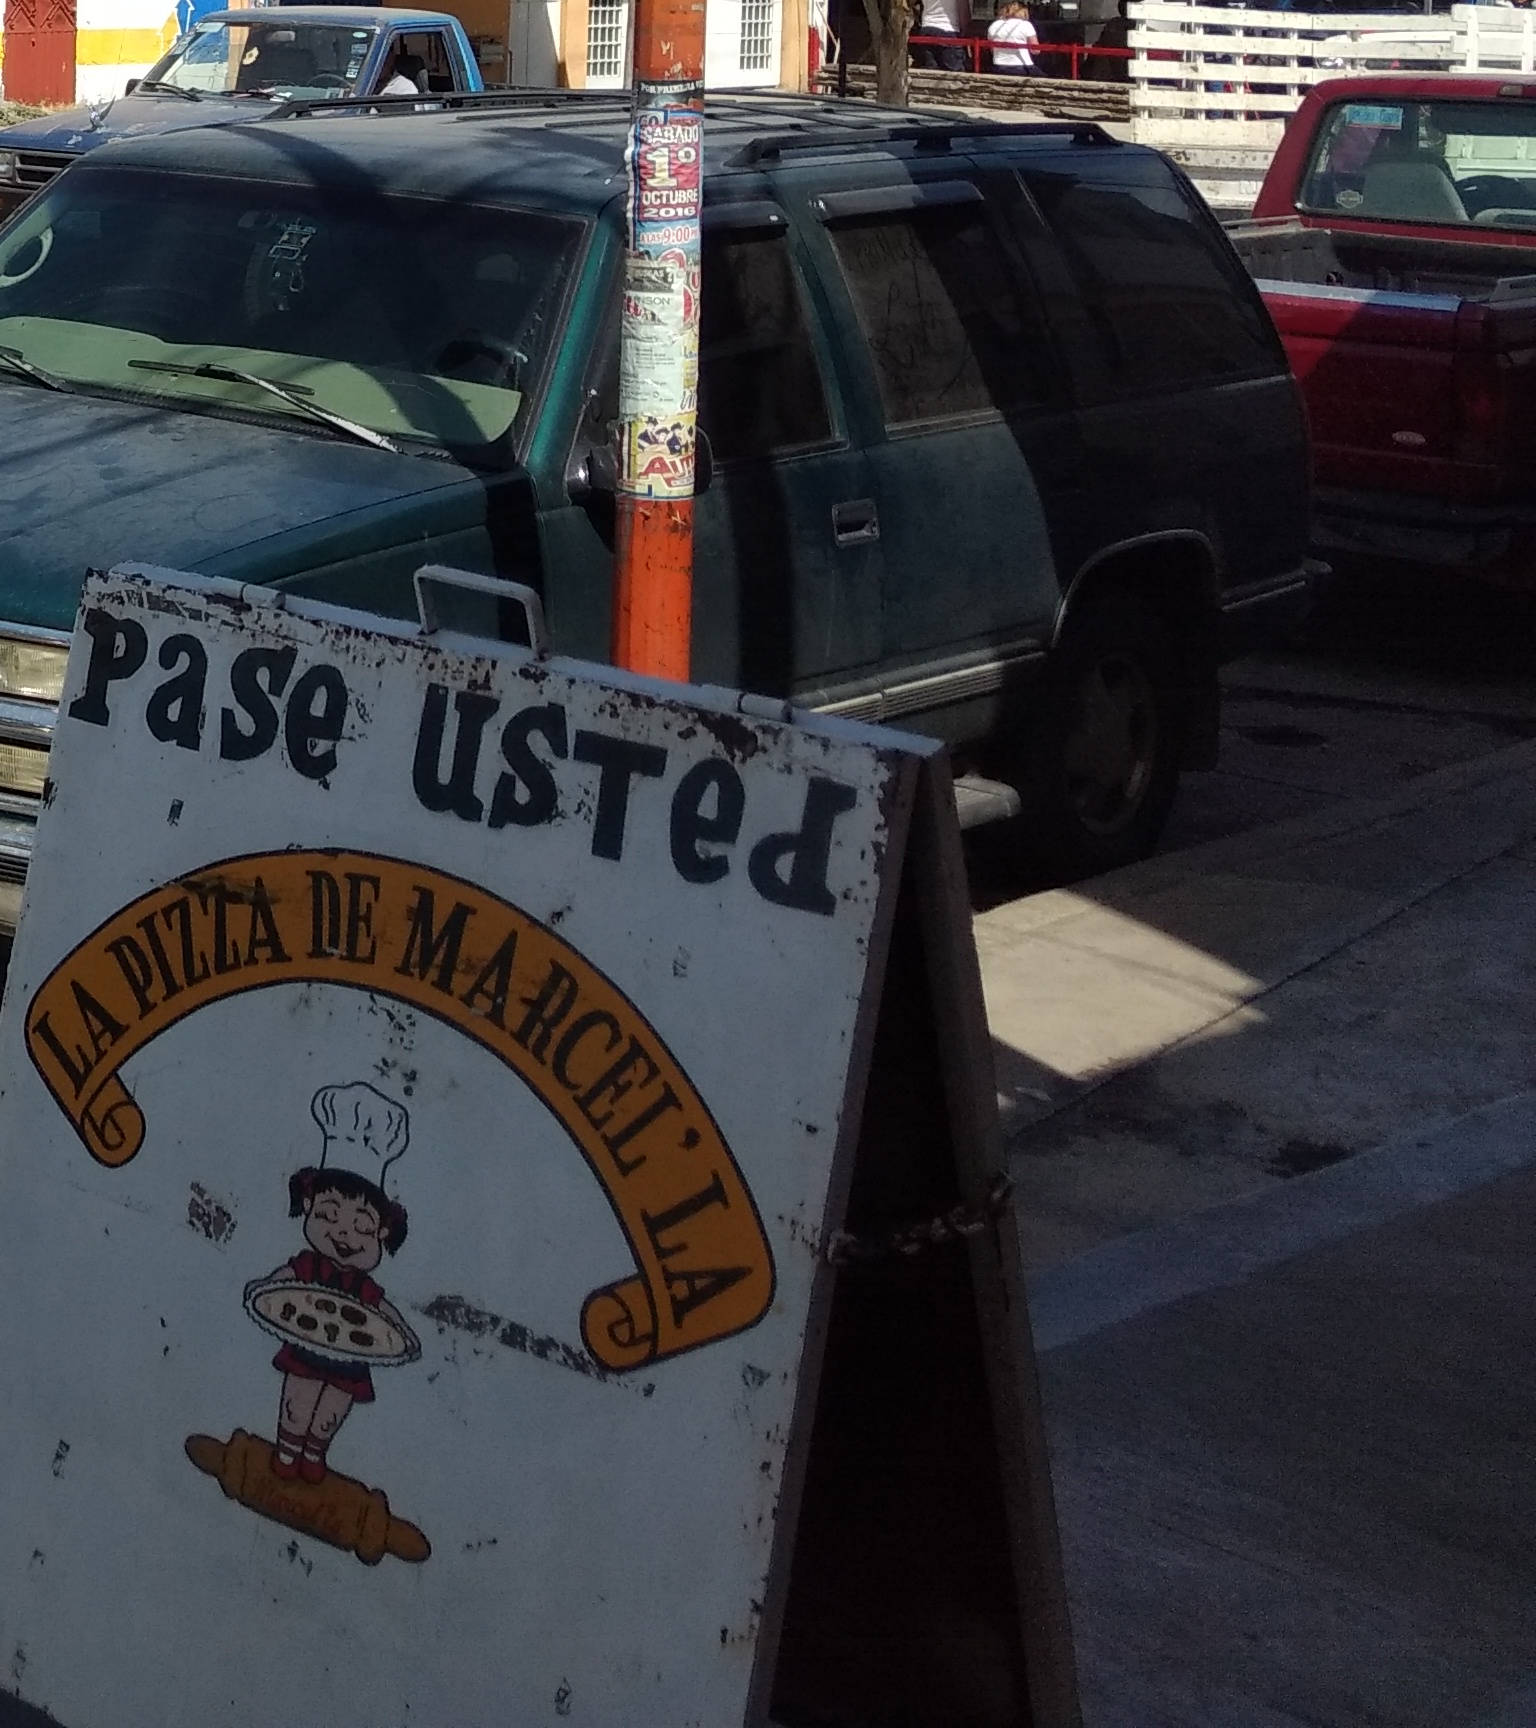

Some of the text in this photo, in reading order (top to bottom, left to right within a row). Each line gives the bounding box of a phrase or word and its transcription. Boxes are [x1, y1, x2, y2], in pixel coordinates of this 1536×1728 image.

[642, 188, 699, 206] OCTUBRE
[643, 206, 697, 218] 2016
[31, 978, 131, 1100] LA
[104, 875, 294, 1021] PIZZA
[305, 869, 381, 965] DE
